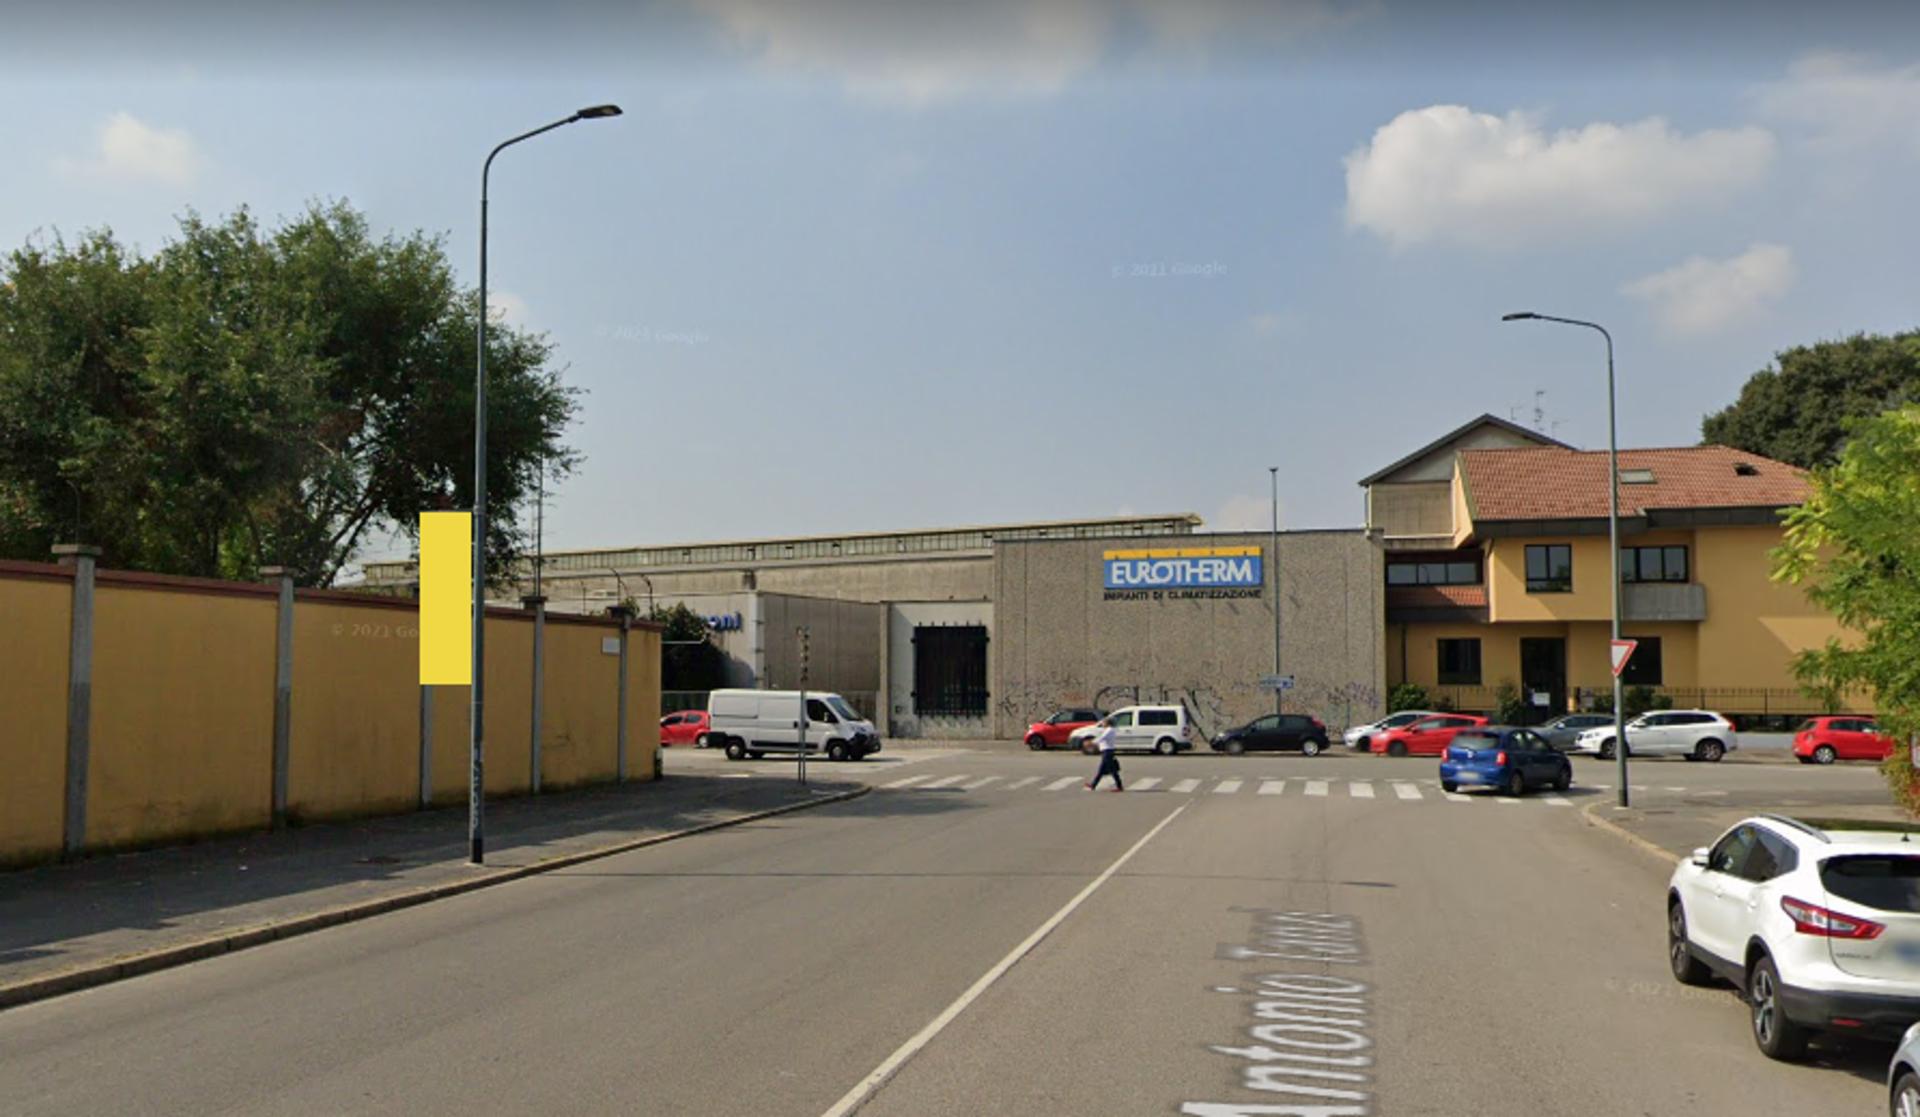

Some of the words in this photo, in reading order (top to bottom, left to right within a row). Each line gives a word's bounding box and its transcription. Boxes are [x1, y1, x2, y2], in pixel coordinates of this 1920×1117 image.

[1112, 559, 1253, 584] EUROTHERM
[1104, 591, 1148, 601] IMPIANTI
[1153, 591, 1163, 600] DI
